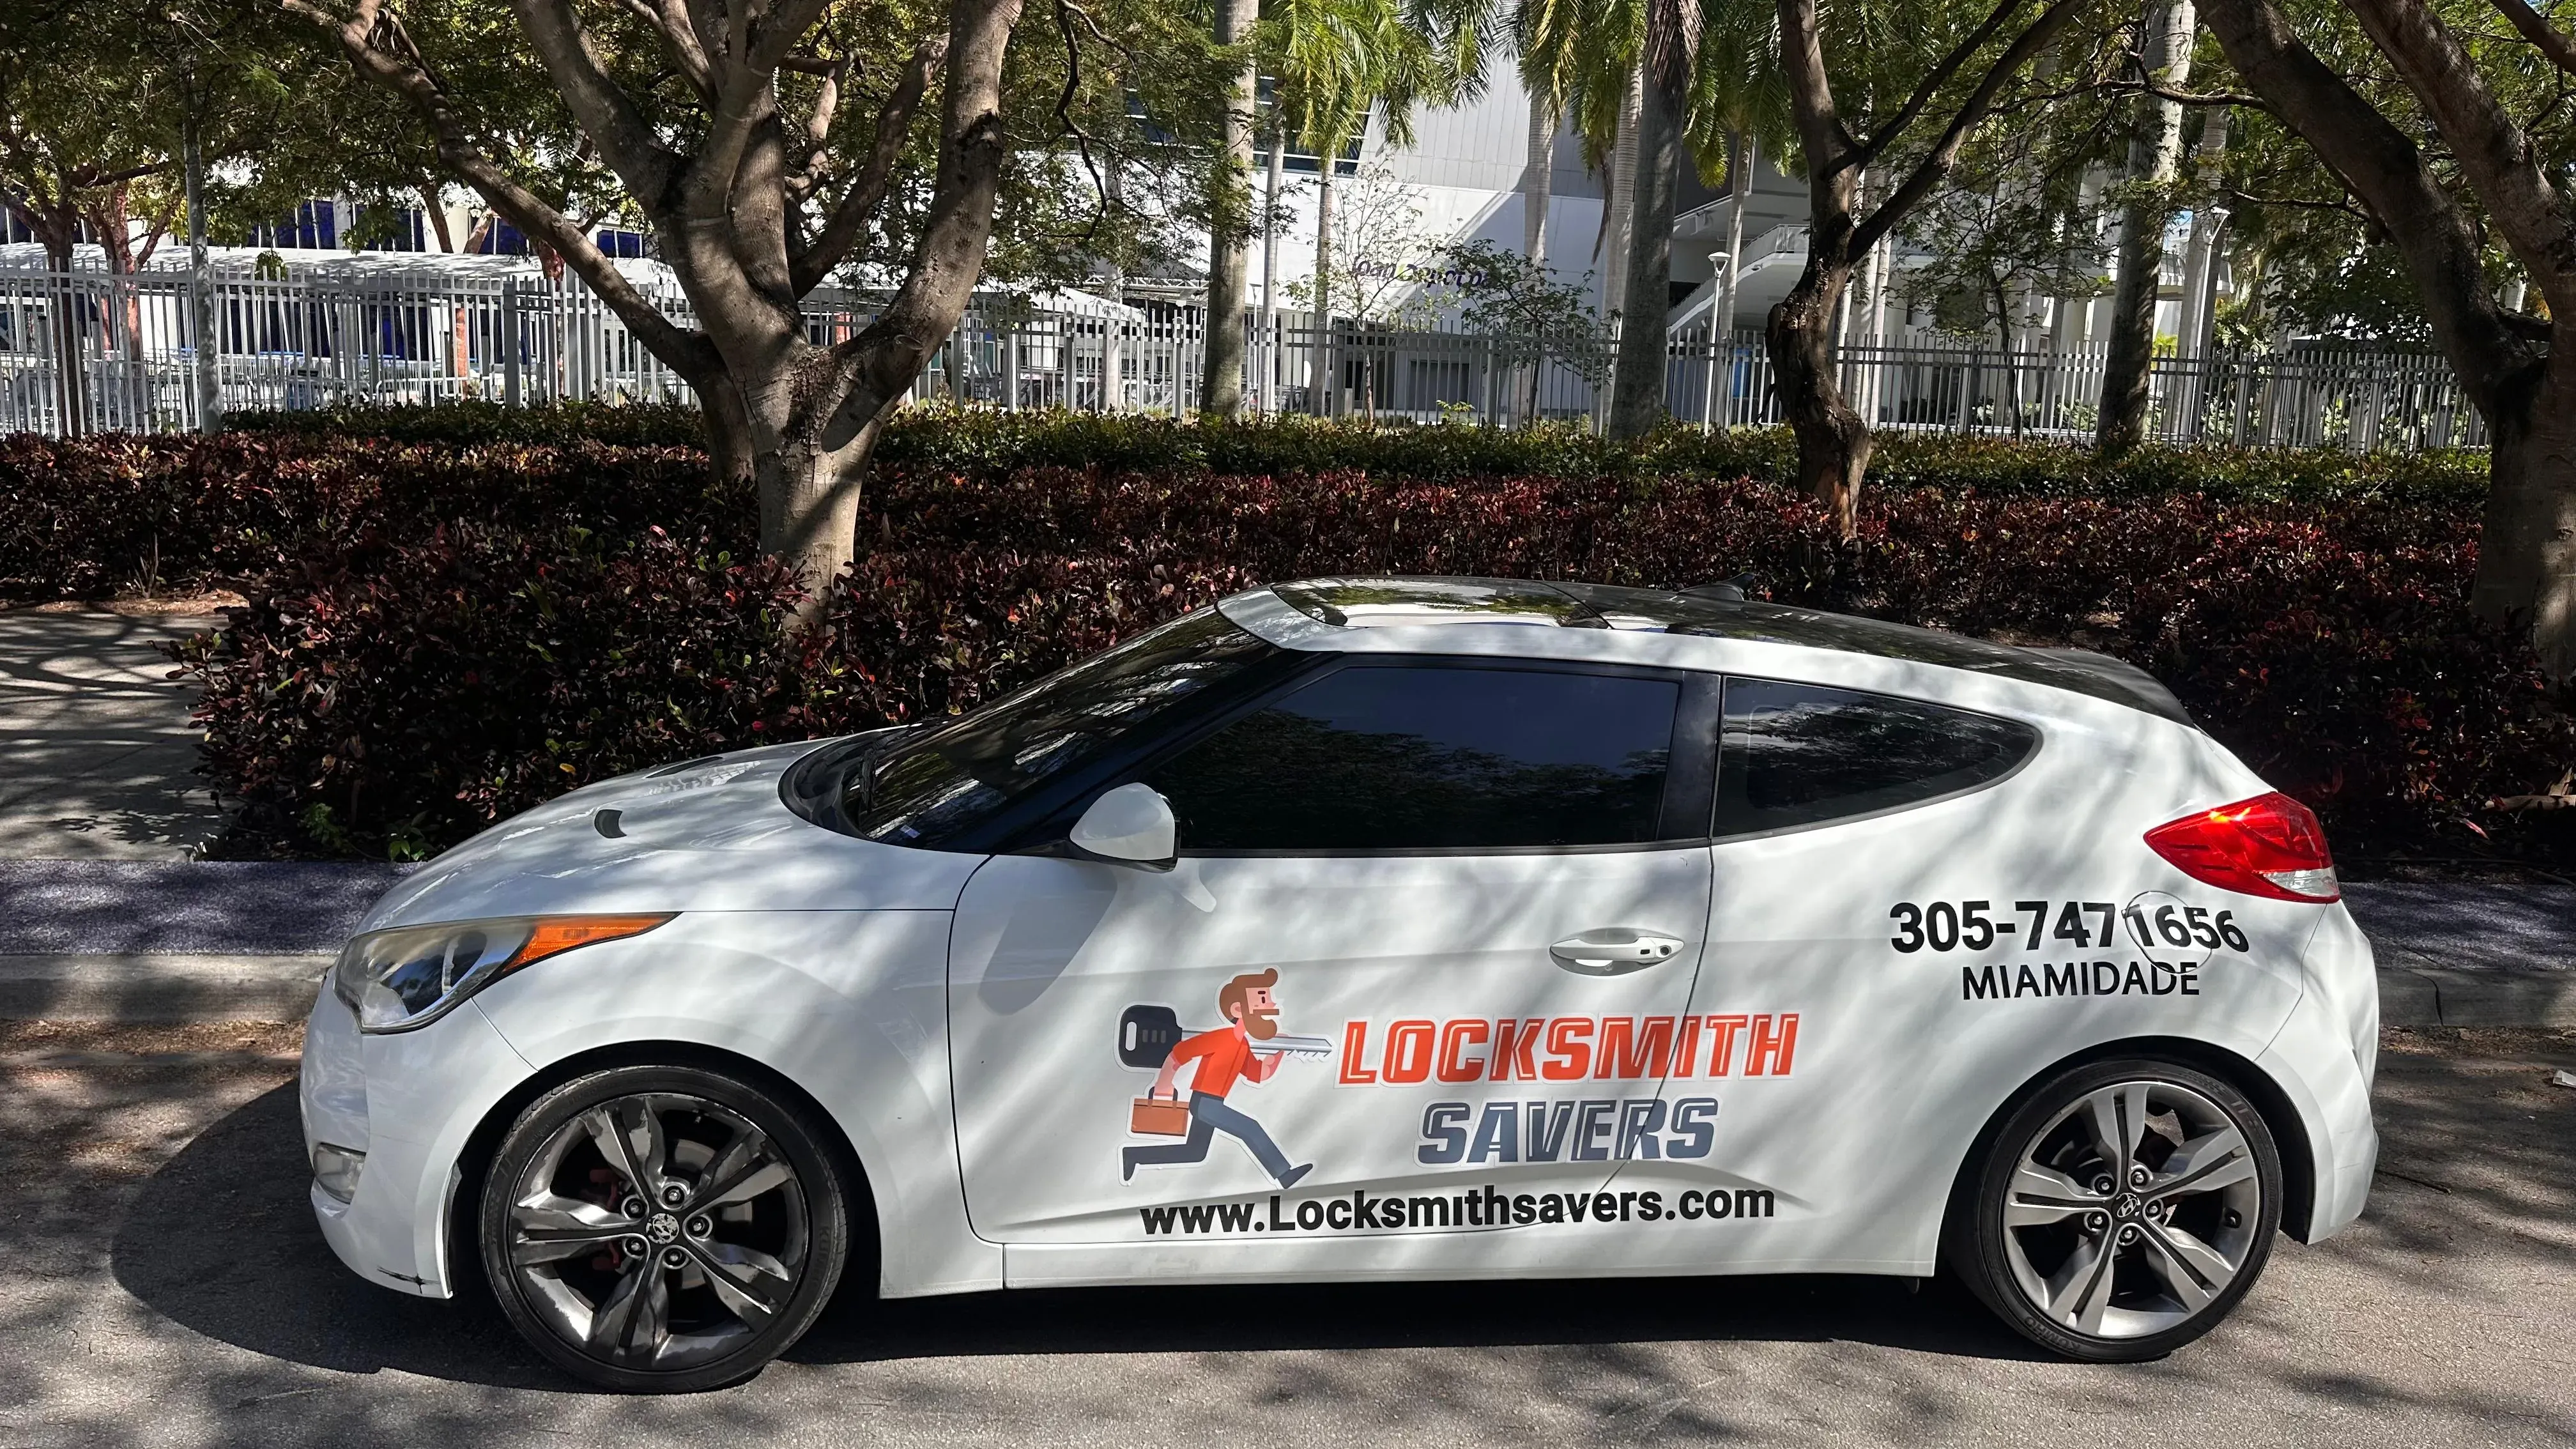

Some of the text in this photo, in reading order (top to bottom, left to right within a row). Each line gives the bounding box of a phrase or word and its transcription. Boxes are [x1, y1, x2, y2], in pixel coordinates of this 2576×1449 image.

[1963, 962, 2200, 1000] MIAMIDADE
[1340, 1014, 1799, 1084] LOCKSMITH
[1418, 1097, 1719, 1165] SAVERS
[1139, 1185, 1774, 1234] www.Locksmithsavers.com
